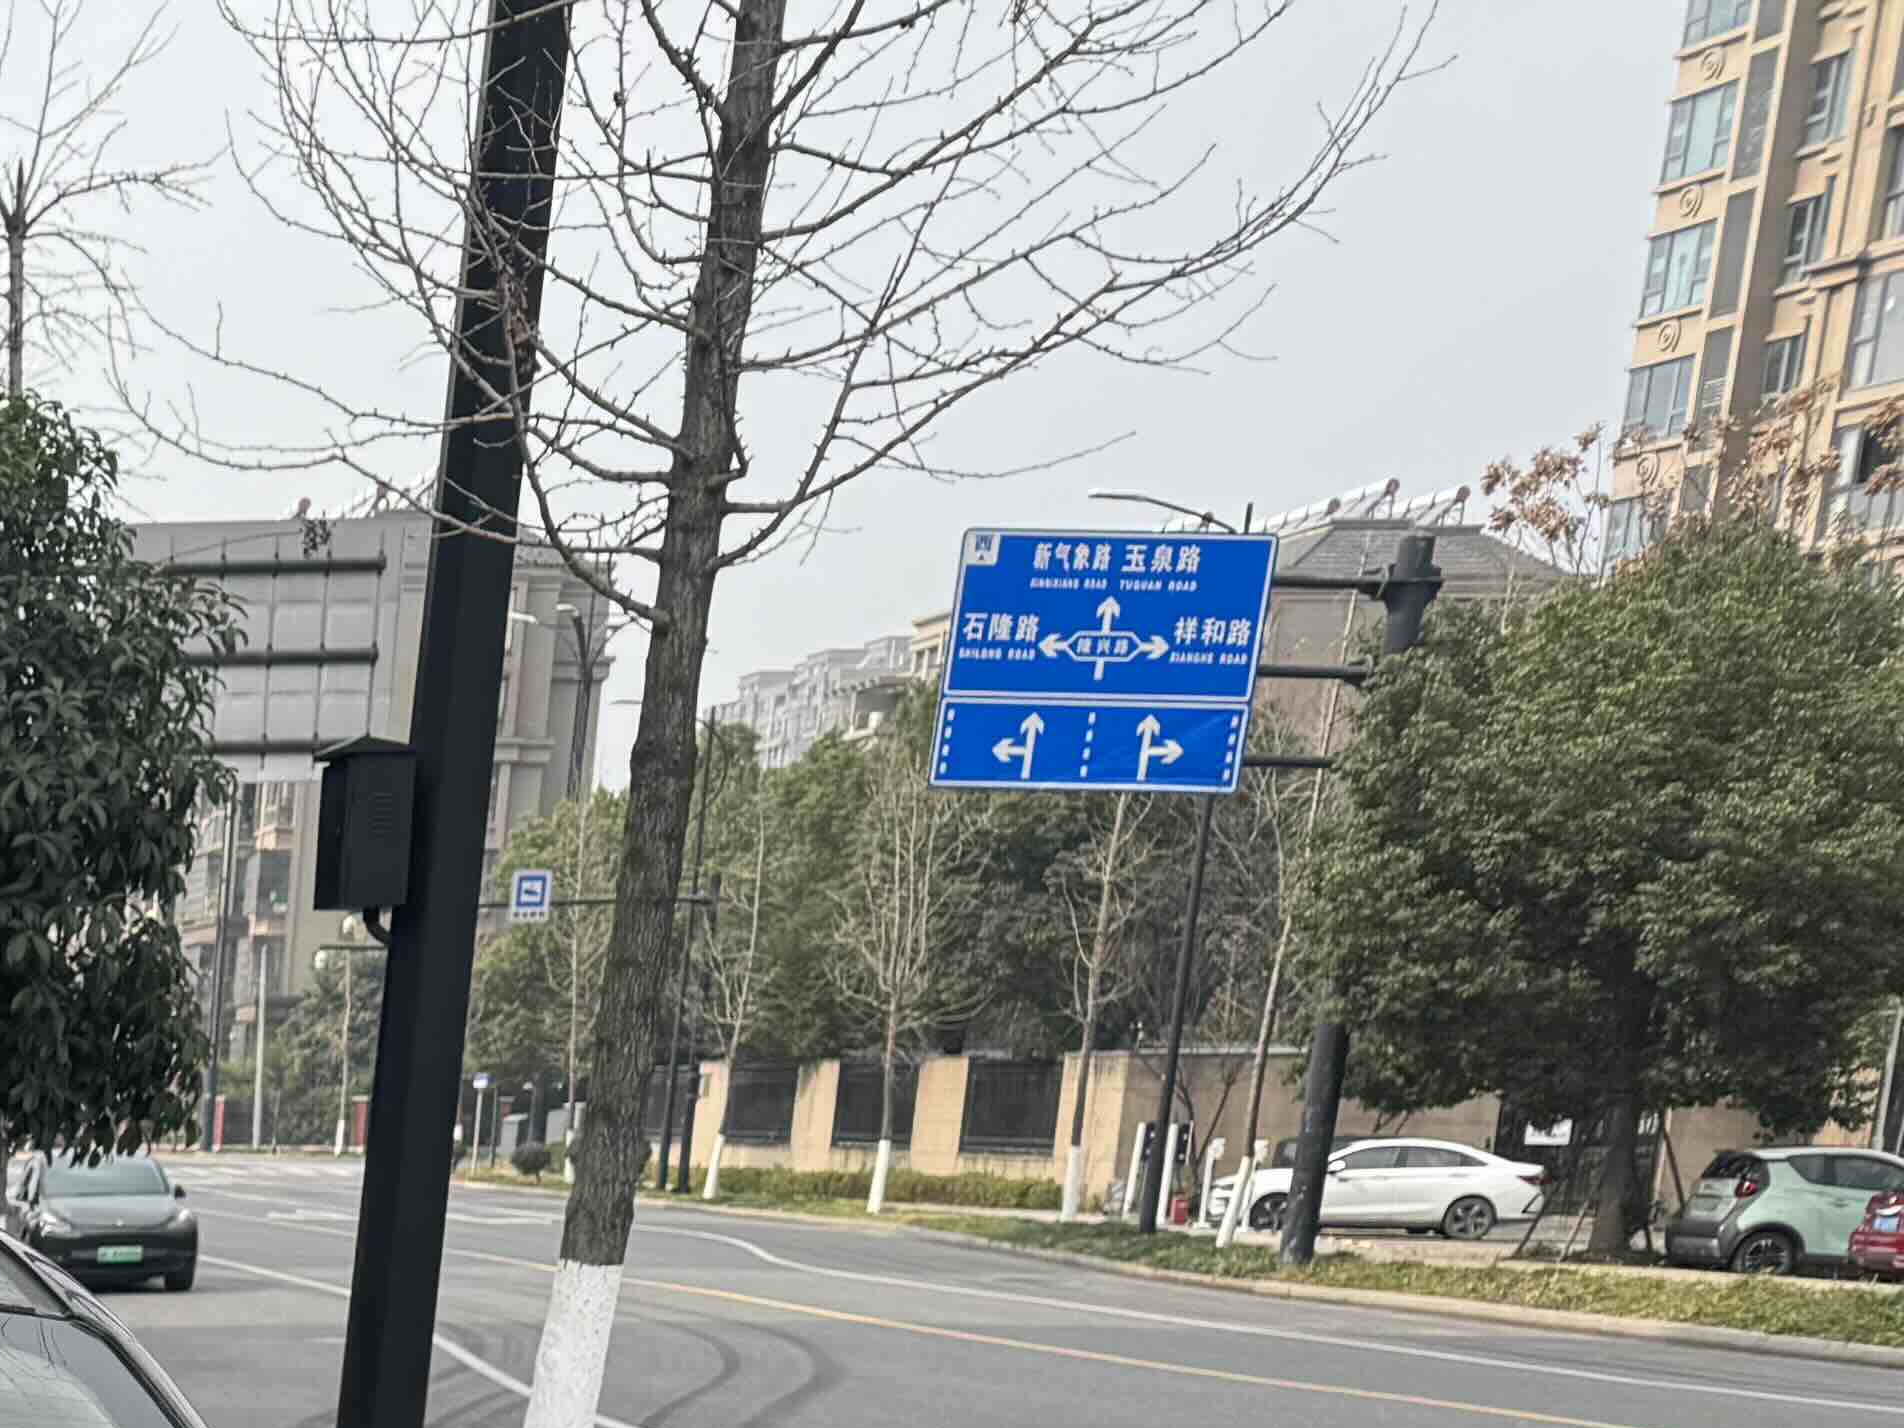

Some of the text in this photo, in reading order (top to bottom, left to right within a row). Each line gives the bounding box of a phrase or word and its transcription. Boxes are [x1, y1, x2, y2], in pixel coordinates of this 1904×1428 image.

[1033, 541, 1201, 573] 新气象路 玉泉路
[1167, 580, 1198, 592] ROAD
[962, 612, 1041, 641] 石隆路
[1174, 615, 1252, 646] 祥和路
[1007, 647, 1037, 660] ROAD
[1218, 652, 1249, 665] ROAD
